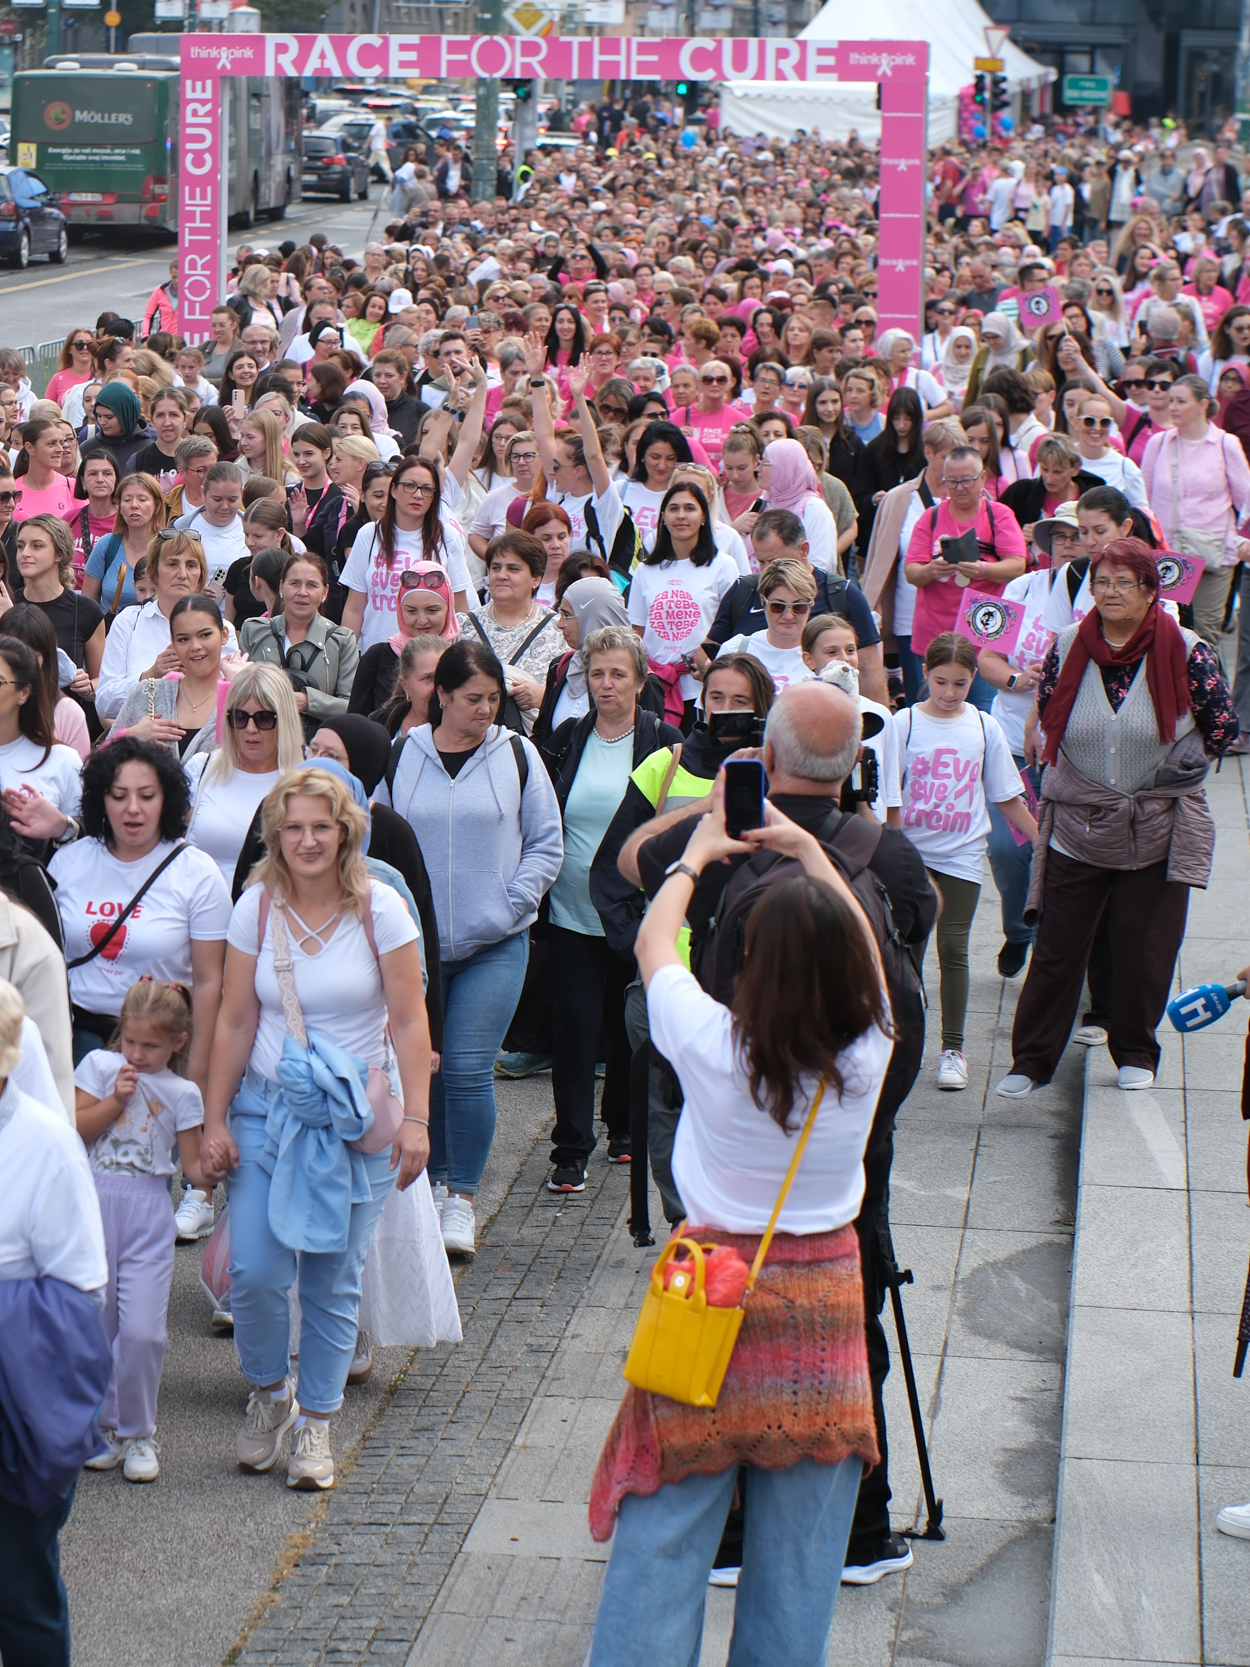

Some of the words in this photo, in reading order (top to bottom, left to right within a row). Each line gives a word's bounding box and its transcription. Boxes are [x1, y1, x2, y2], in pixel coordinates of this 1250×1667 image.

[265, 34, 421, 76] RACE
[440, 35, 549, 78] FOR
[559, 36, 662, 80] THE
[678, 38, 839, 81] CURE
[185, 79, 213, 175] CURE
[184, 185, 212, 247] THE
[184, 254, 212, 319] FOR
[910, 779, 949, 806] sve
[1178, 996, 1213, 1029] H
